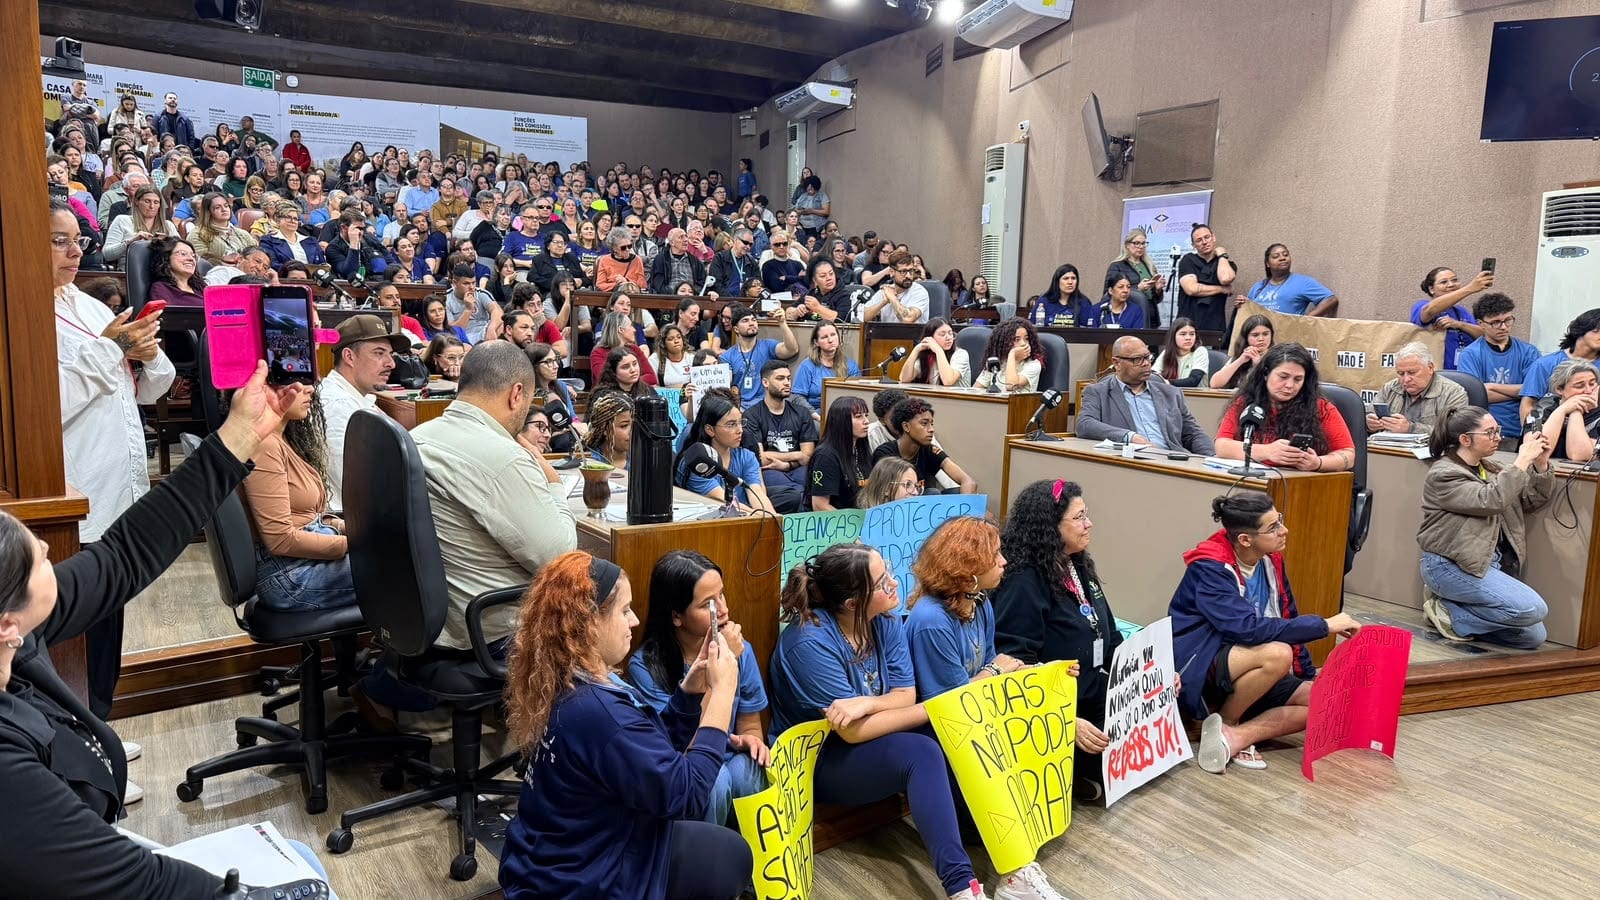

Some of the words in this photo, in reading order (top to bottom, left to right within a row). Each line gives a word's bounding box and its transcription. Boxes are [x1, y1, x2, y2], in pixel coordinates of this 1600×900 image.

[86, 72, 103, 80] MARA
[245, 70, 272, 82] SAÍDA
[47, 83, 71, 94] CASA
[116, 81, 143, 91] FUNÇÕES
[127, 89, 153, 98] CÂMARA
[514, 127, 553, 135] PARLAMENTARES
[1337, 352, 1356, 367] NÃO
[1358, 353, 1364, 368] É
[1381, 354, 1394, 367] FA
[868, 502, 972, 539] PROTEGER
[783, 514, 860, 543] RIANÇAS
[960, 691, 983, 723] O
[982, 673, 1045, 718] SUAS
[1134, 707, 1139, 724] O
[1142, 699, 1155, 719] POVO
[971, 722, 1012, 779] NÃO
[1004, 702, 1075, 764] PODE
